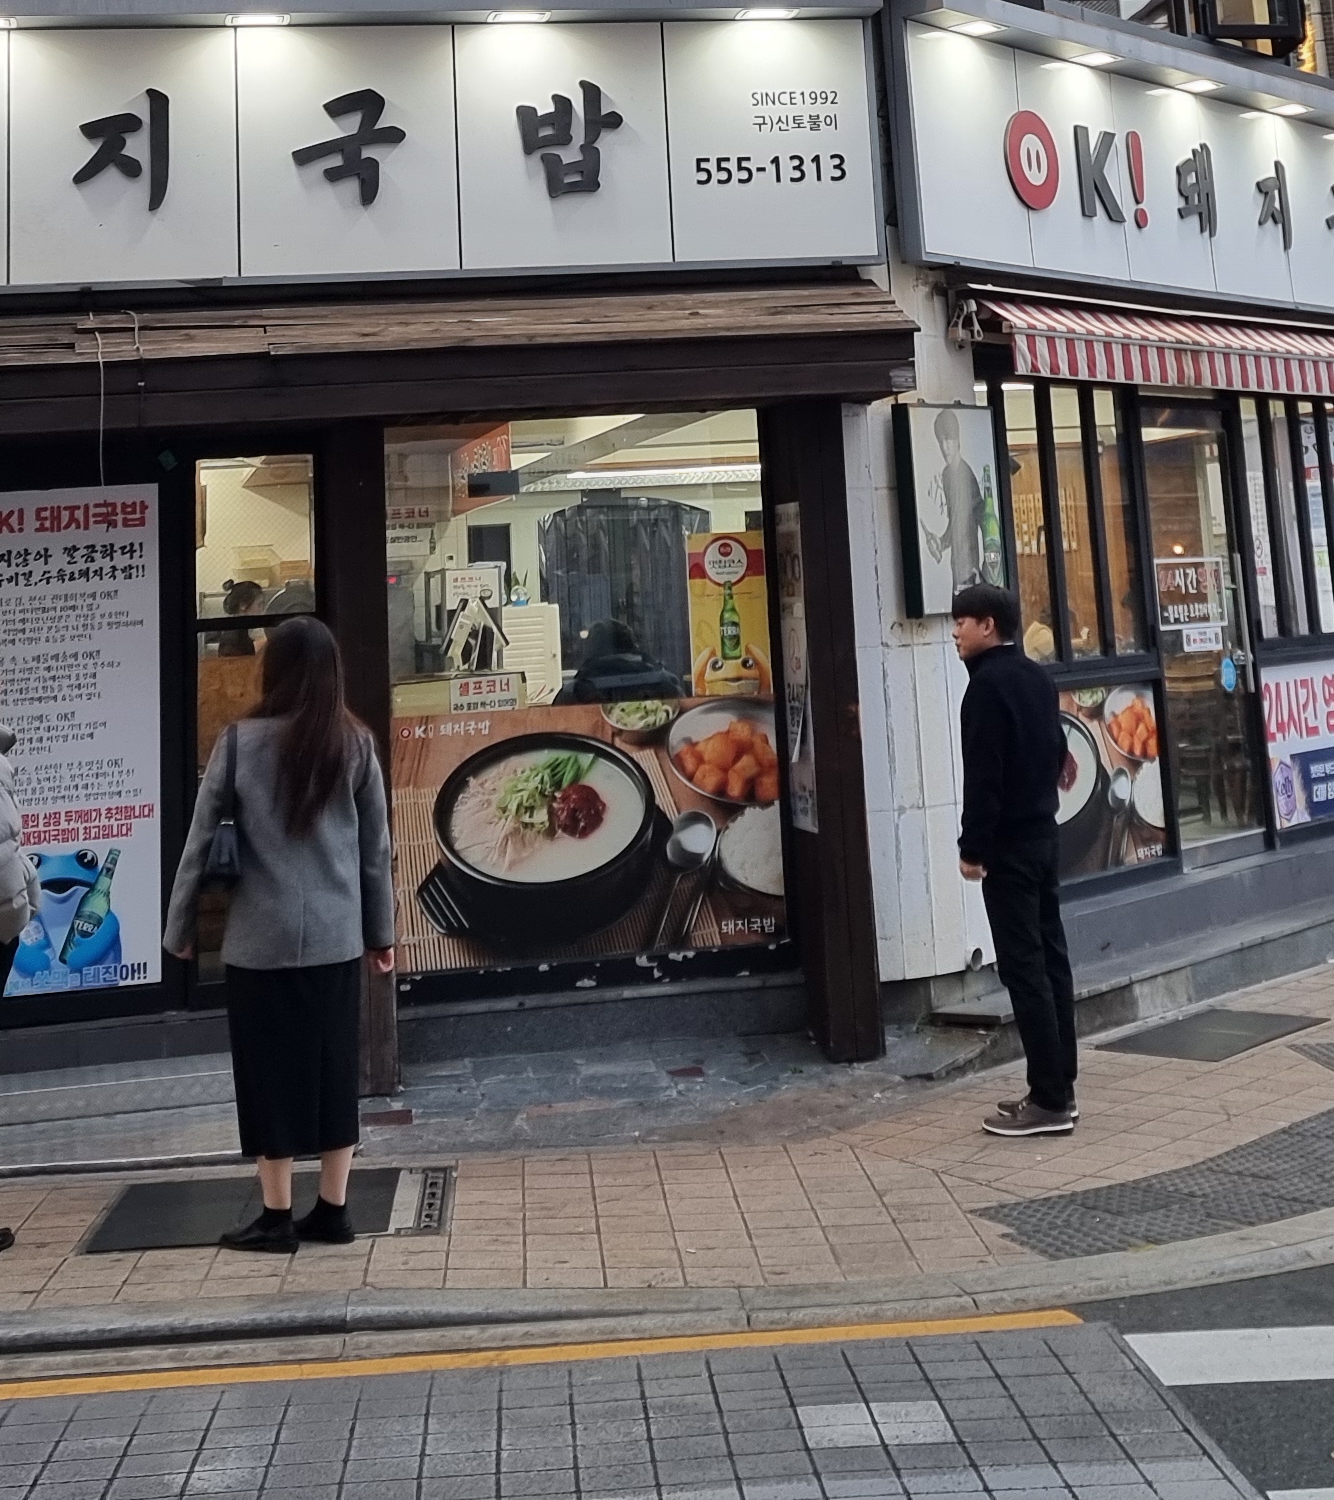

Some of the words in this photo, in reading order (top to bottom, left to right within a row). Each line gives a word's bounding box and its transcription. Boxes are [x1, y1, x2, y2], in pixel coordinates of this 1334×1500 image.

[694, 152, 848, 187] 555-1313
[34, 499, 149, 534] 돼지국밥
[458, 677, 511, 697] 셀프코너
[1263, 677, 1321, 743] 24시간
[64, 807, 103, 825] 두꺼비가
[104, 803, 155, 822] 추천합니다!
[82, 822, 133, 842] 최고입니다!
[720, 915, 777, 936] 돼지국밥
